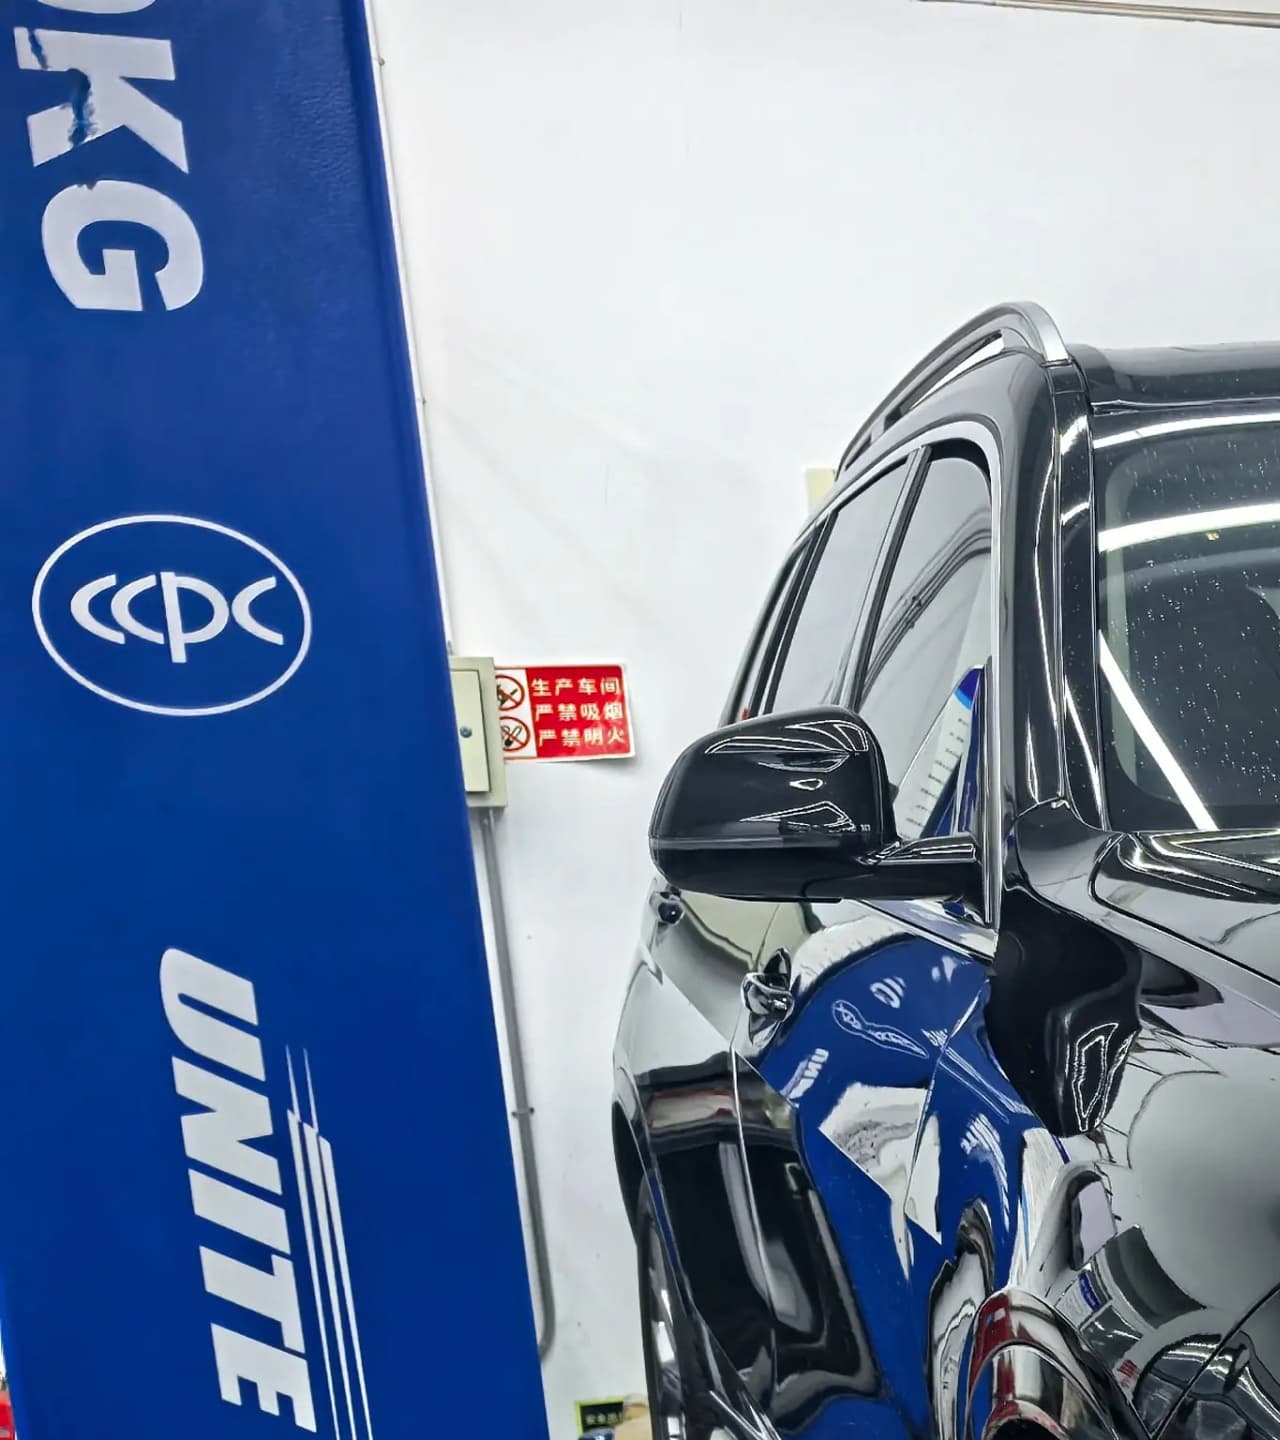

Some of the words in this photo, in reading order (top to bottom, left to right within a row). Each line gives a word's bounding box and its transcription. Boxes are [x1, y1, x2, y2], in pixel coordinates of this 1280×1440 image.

[14, 0, 204, 311] KG
[531, 677, 621, 697] 生产车间
[535, 702, 624, 722] 严禁吸烟
[538, 726, 625, 747] 严禁明火
[159, 947, 316, 1432] UNITE
